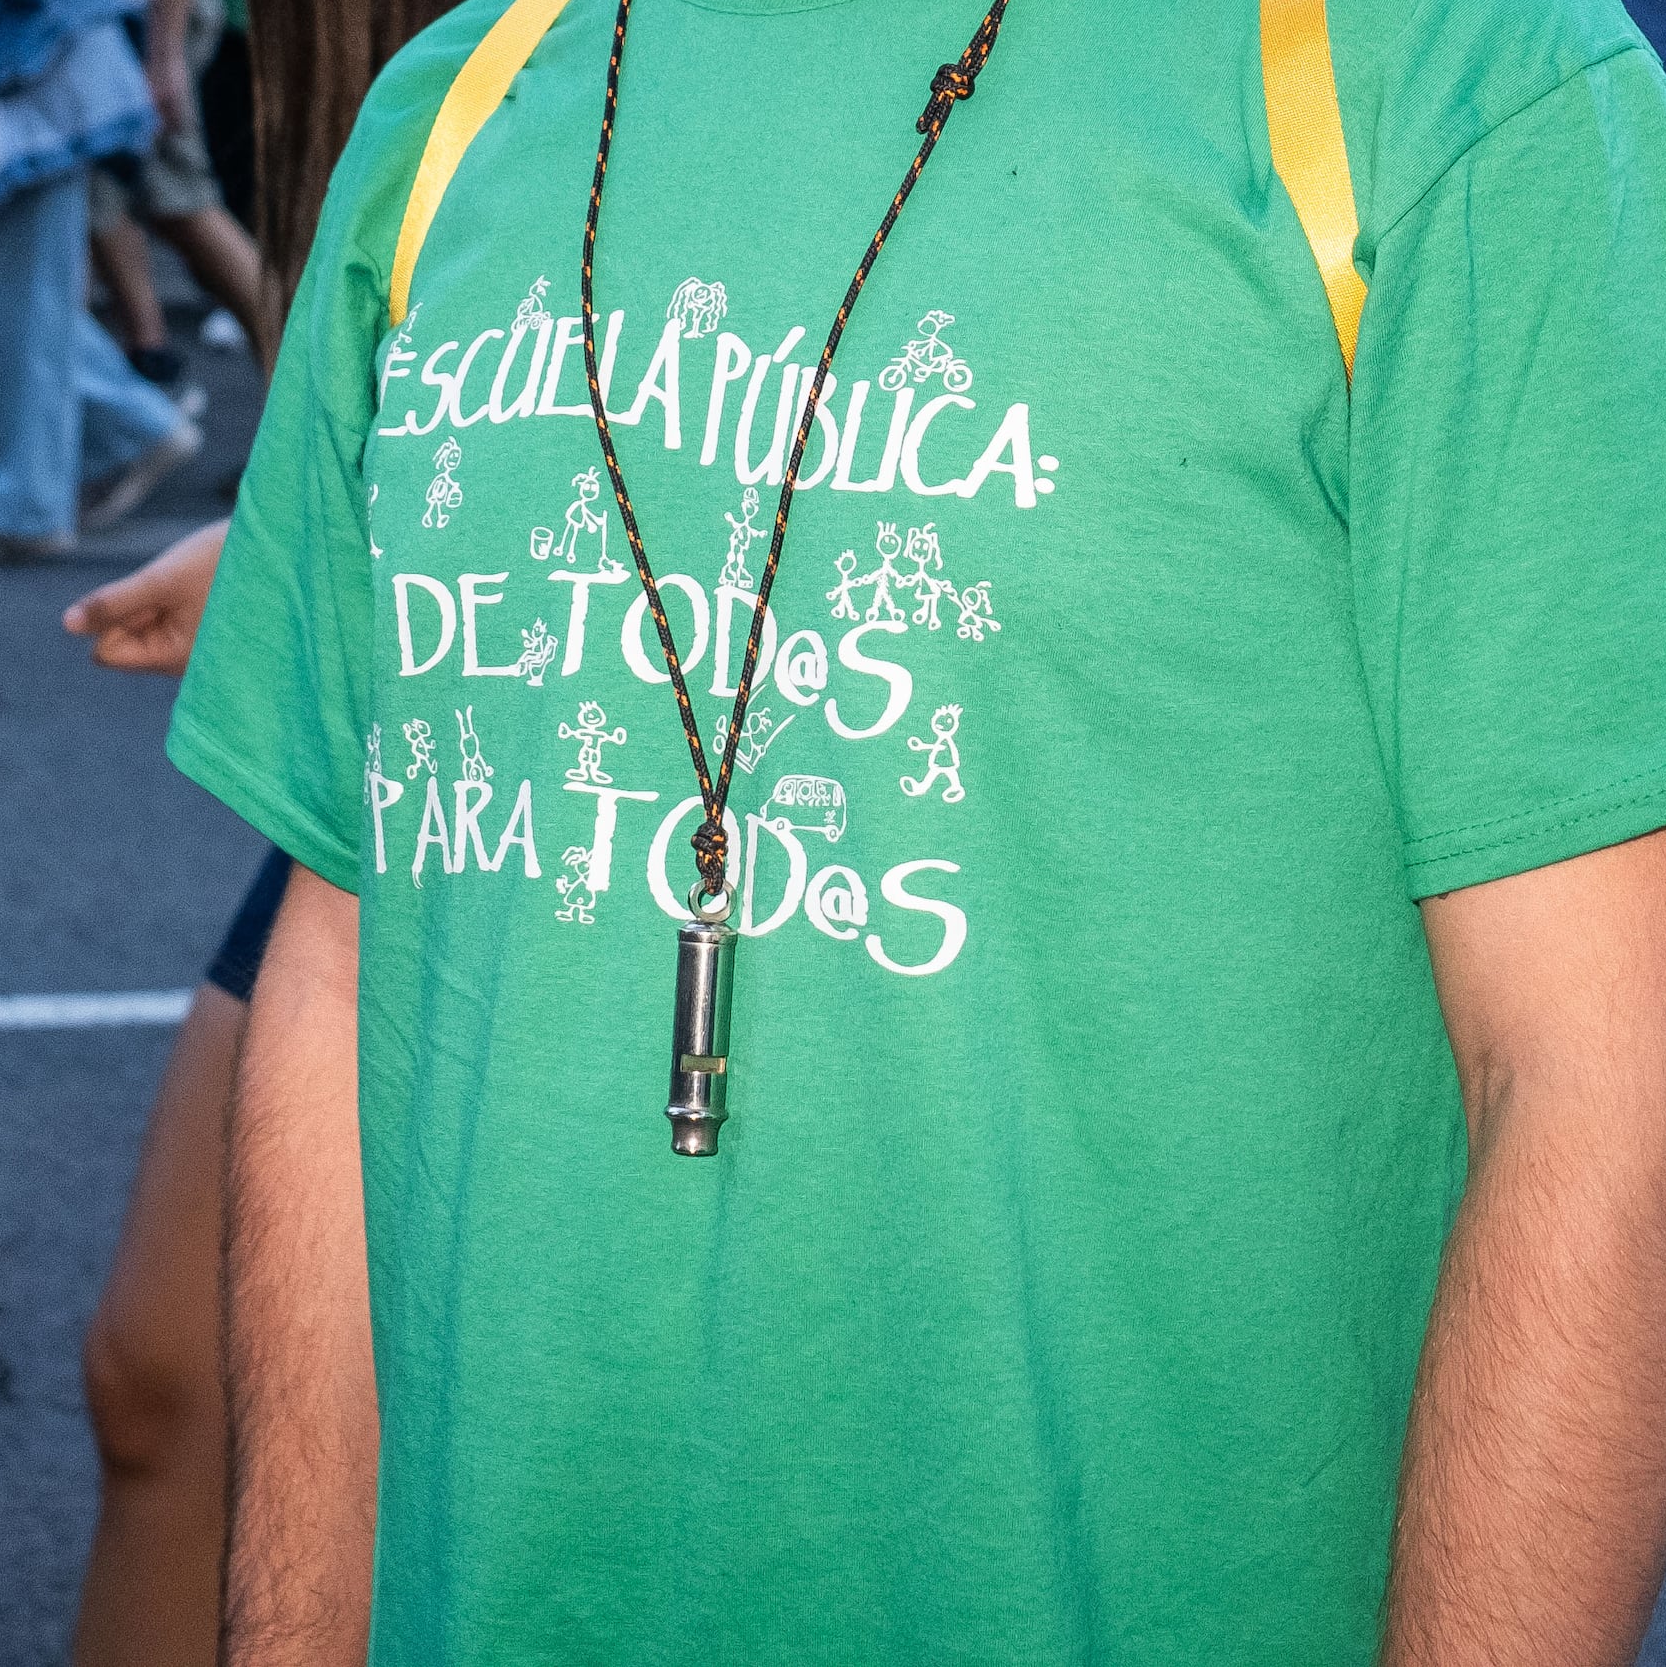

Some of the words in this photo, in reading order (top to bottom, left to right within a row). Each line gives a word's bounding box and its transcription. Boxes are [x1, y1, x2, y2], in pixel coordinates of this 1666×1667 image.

[377, 309, 682, 450] ESCUELA
[699, 325, 1061, 510] PÚBLICA:
[391, 571, 521, 677] DE
[547, 569, 913, 740] TOD@S
[370, 774, 542, 881] PARA
[562, 780, 968, 977] TOD@S
